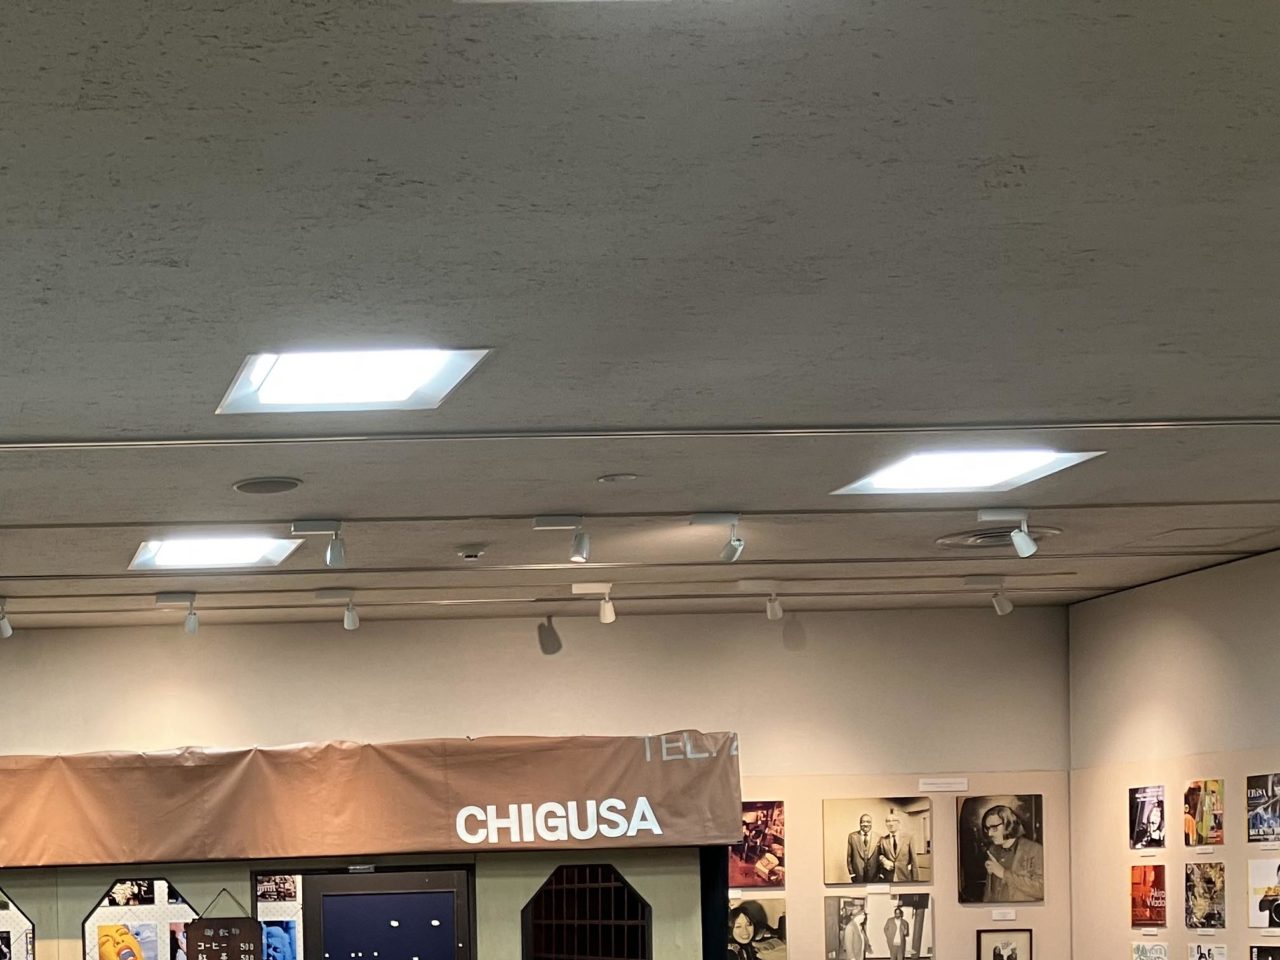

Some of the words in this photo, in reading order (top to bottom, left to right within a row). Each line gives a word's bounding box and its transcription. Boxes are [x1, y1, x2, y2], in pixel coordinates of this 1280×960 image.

[455, 796, 664, 844] CHIGUSA
[197, 942, 228, 950] コーヒー
[240, 943, 255, 951] 500
